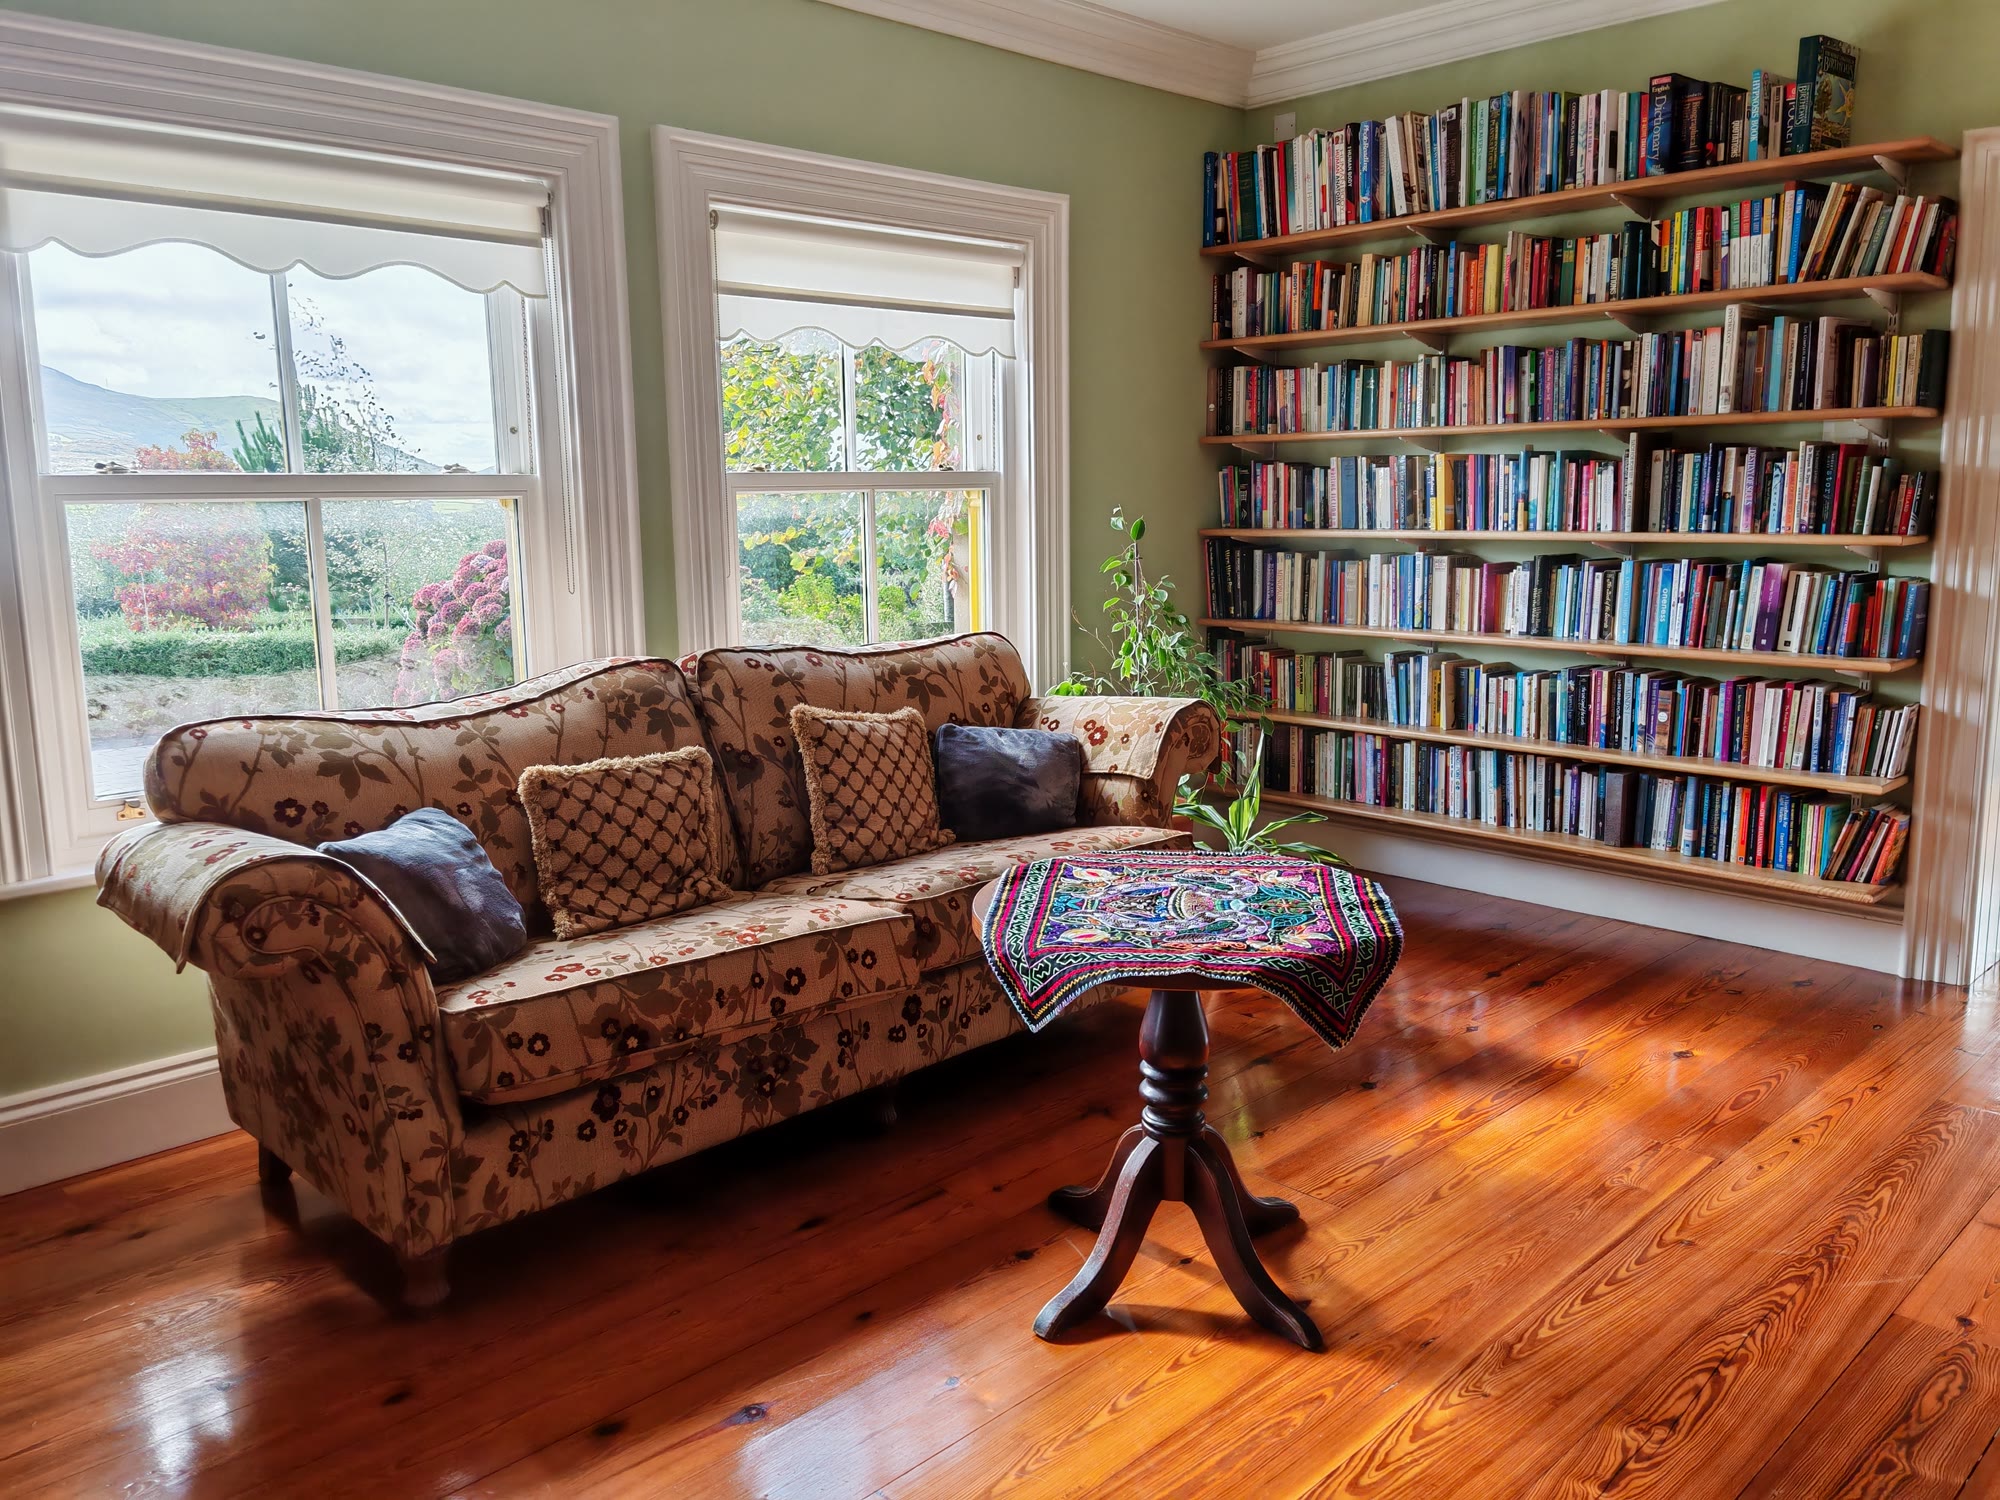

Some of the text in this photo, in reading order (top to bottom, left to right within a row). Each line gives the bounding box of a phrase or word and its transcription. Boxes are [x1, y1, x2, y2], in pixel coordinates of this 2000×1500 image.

[1750, 79, 1761, 143] HYPNOSIS BOOK
[1795, 85, 1807, 125] BIRTHDAYS
[1647, 94, 1667, 161] Dictionary
[1689, 101, 1701, 149] Biographical
[1730, 120, 1741, 158] QUOTATIONS
[1362, 124, 1370, 172] PhotoReading
[1872, 215, 1885, 243] KINDNESS
[1609, 257, 1619, 295] QUOTATIONS
[1725, 307, 1735, 344] PSYCHOLOGY
[1744, 448, 1756, 506] DESTINY OF SOULS
[1823, 470, 1834, 500] story
[1276, 569, 1284, 605] MENOPAUSE
[1659, 588, 1670, 623] oneness
[1905, 594, 1914, 622] Meditation
[1815, 691, 1823, 718] INSPIRATION
